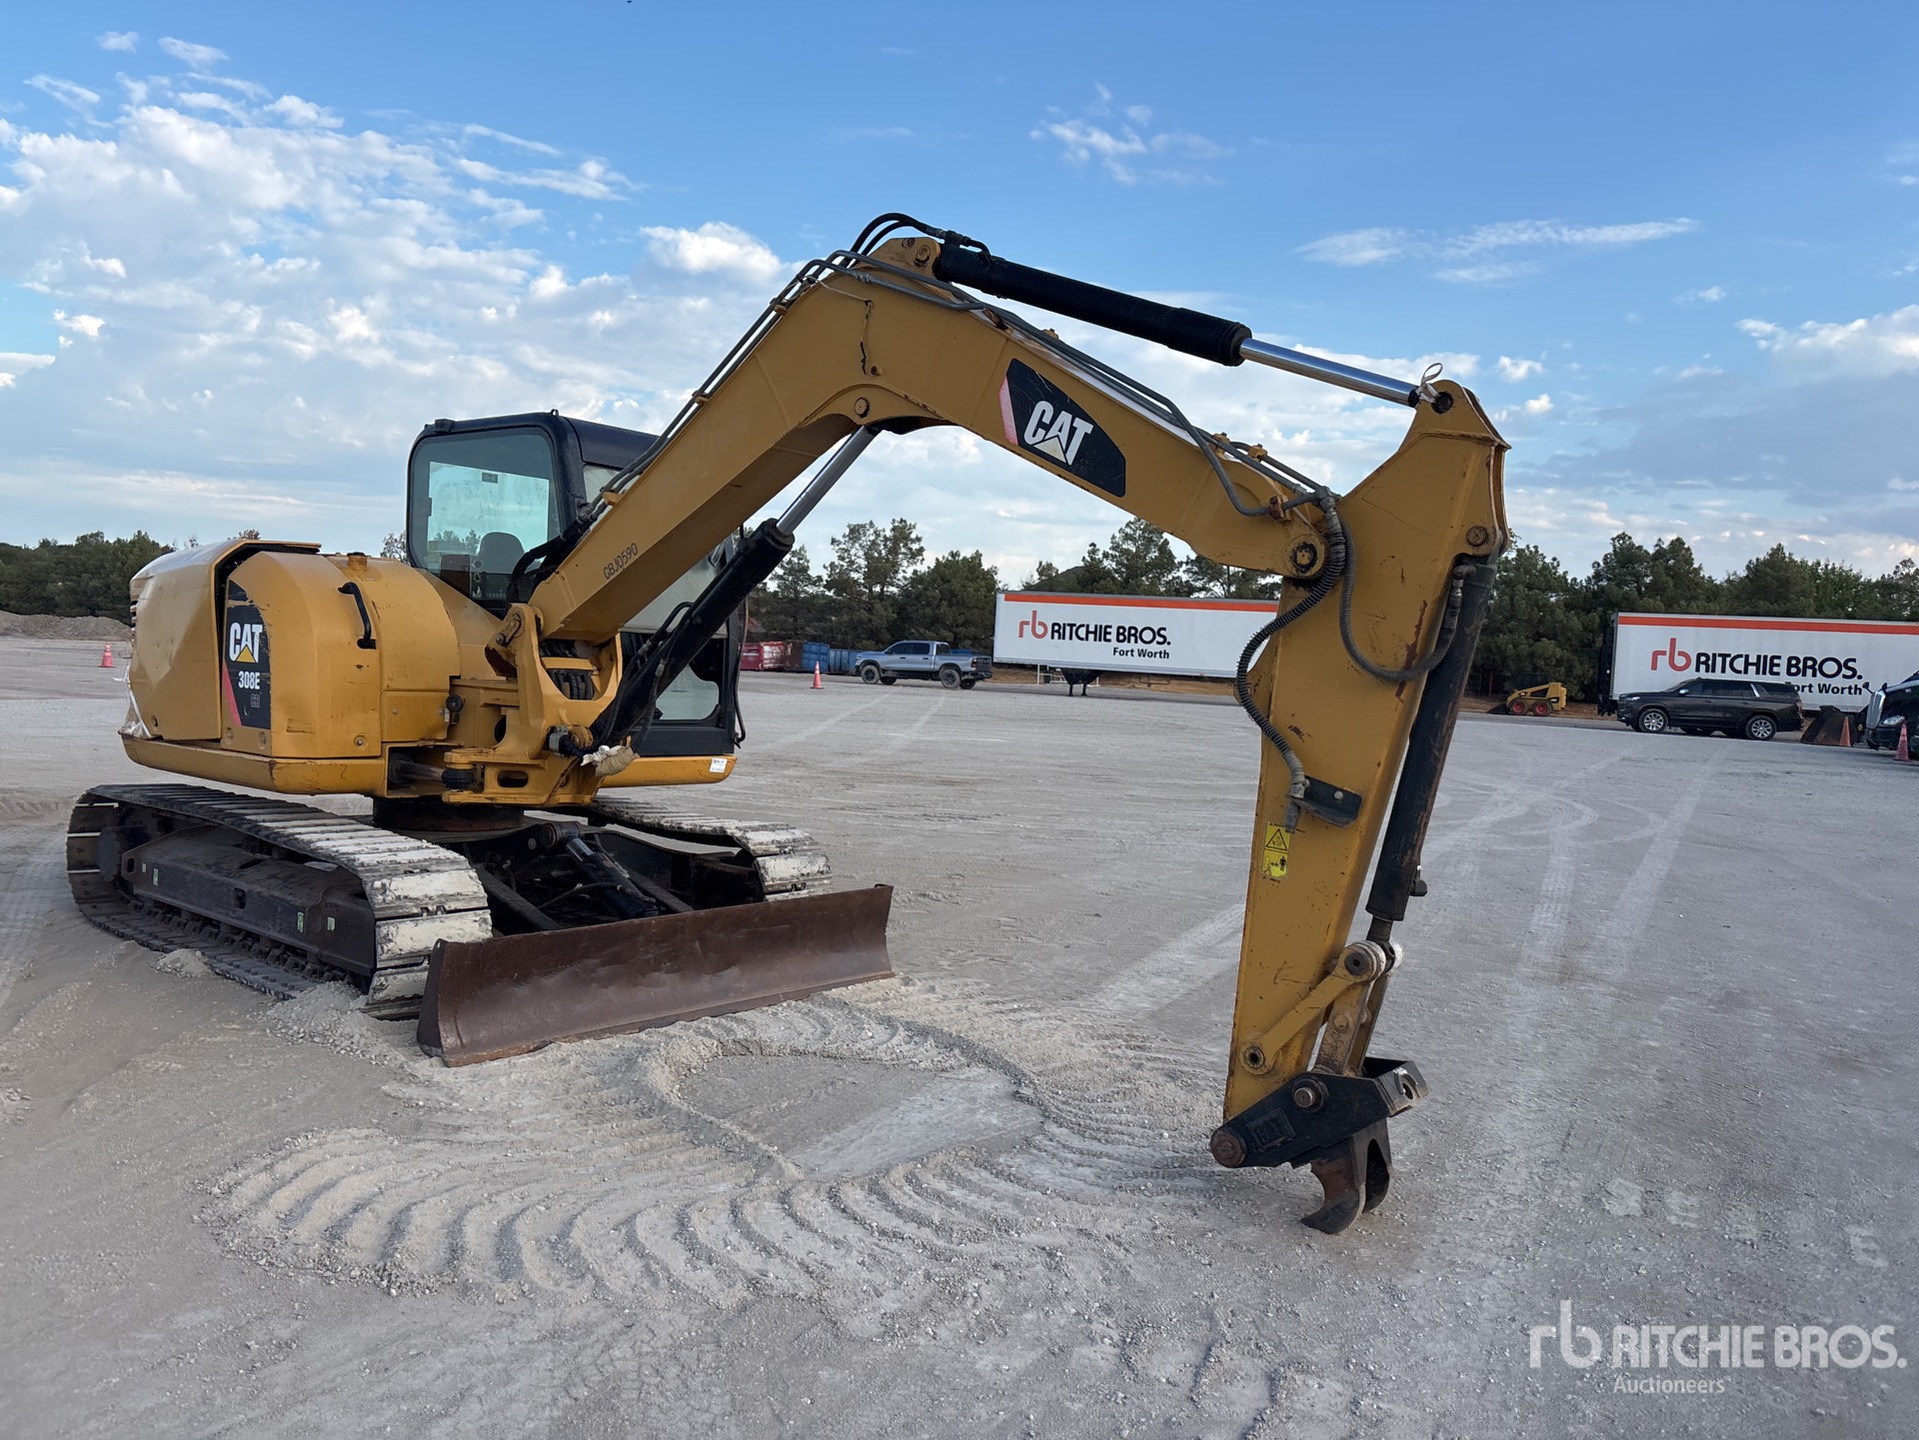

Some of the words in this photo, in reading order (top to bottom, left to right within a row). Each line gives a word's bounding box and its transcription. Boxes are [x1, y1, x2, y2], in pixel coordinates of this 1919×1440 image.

[1024, 401, 1094, 466] CAT
[229, 622, 263, 663] CAT
[1050, 622, 1112, 643] RITCHIE
[1115, 625, 1172, 646] BROS.
[1113, 647, 1134, 657] Fort
[1137, 649, 1170, 659] Worth
[1695, 652, 1781, 676] RITCHIE
[1786, 656, 1863, 680] BROS.
[238, 671, 260, 690] 308E
[1794, 683, 1813, 693] ort
[1817, 683, 1863, 696] Worth
